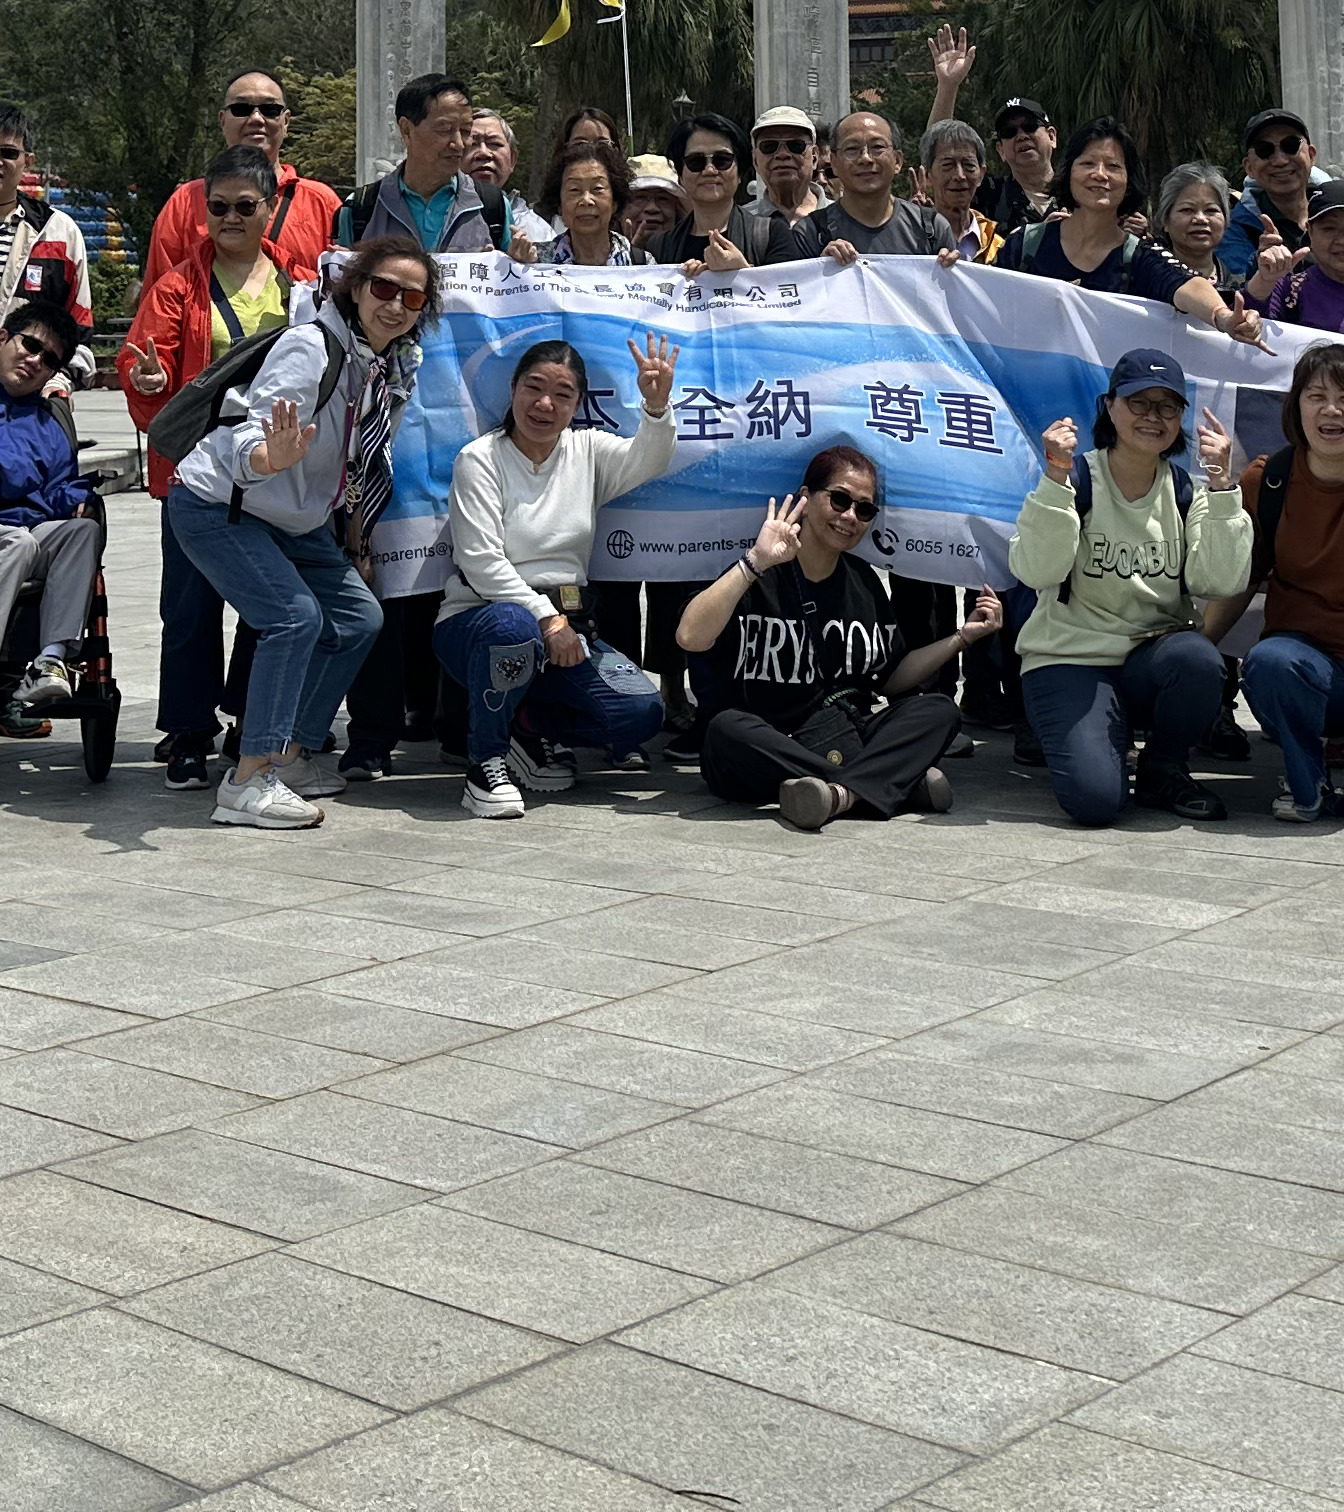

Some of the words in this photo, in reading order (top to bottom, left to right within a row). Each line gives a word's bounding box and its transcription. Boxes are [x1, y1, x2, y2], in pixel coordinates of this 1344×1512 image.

[471, 285, 483, 294] of
[485, 284, 530, 297] Parents
[533, 283, 546, 292] of
[628, 292, 673, 312] Mentally
[673, 379, 811, 441] 全納
[863, 380, 1004, 455] 尊重
[906, 539, 943, 554] 6055
[948, 543, 981, 558] 1627
